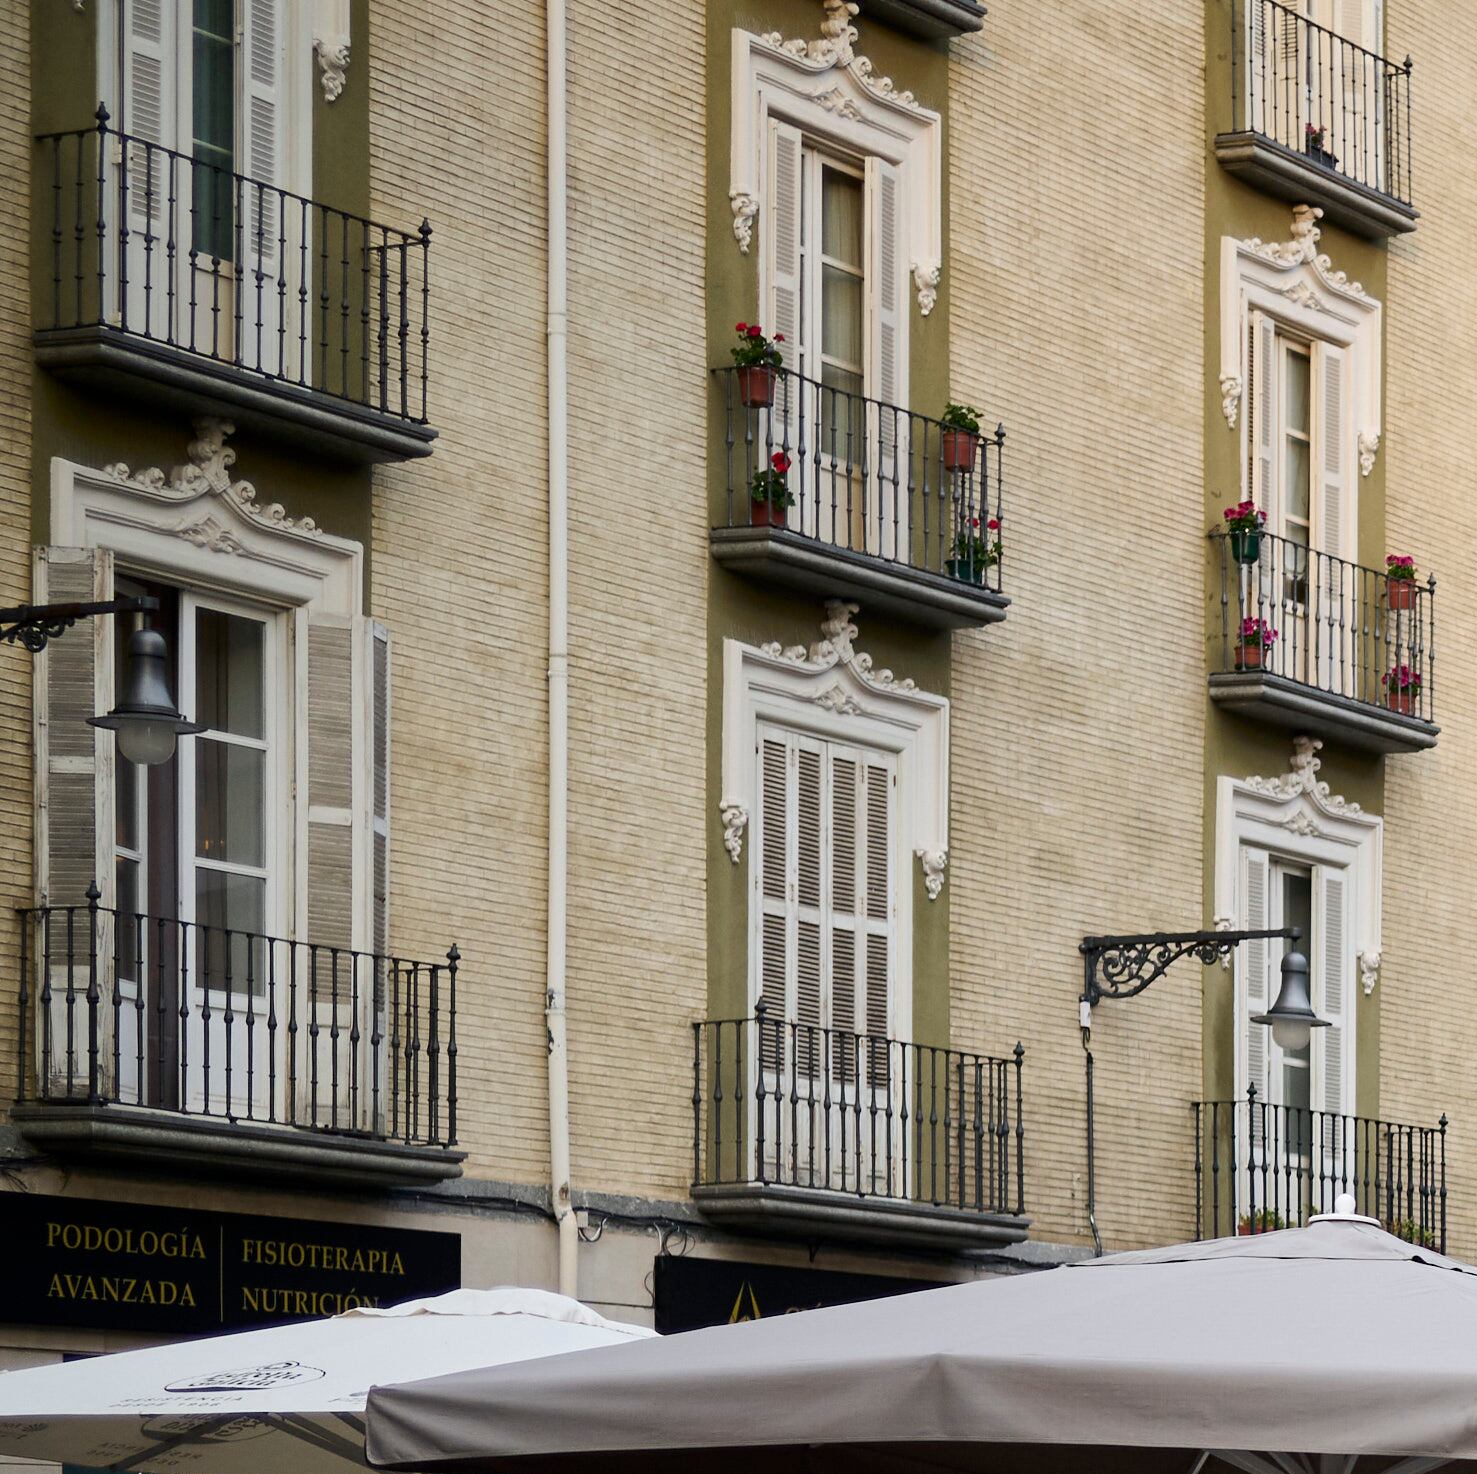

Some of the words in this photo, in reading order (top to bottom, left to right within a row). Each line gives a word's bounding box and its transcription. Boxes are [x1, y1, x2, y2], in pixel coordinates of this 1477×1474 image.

[46, 1221, 207, 1260] PODOLOGÍA
[242, 1238, 406, 1277] FISIOTERAPIA
[47, 1273, 198, 1308] AVANZADA
